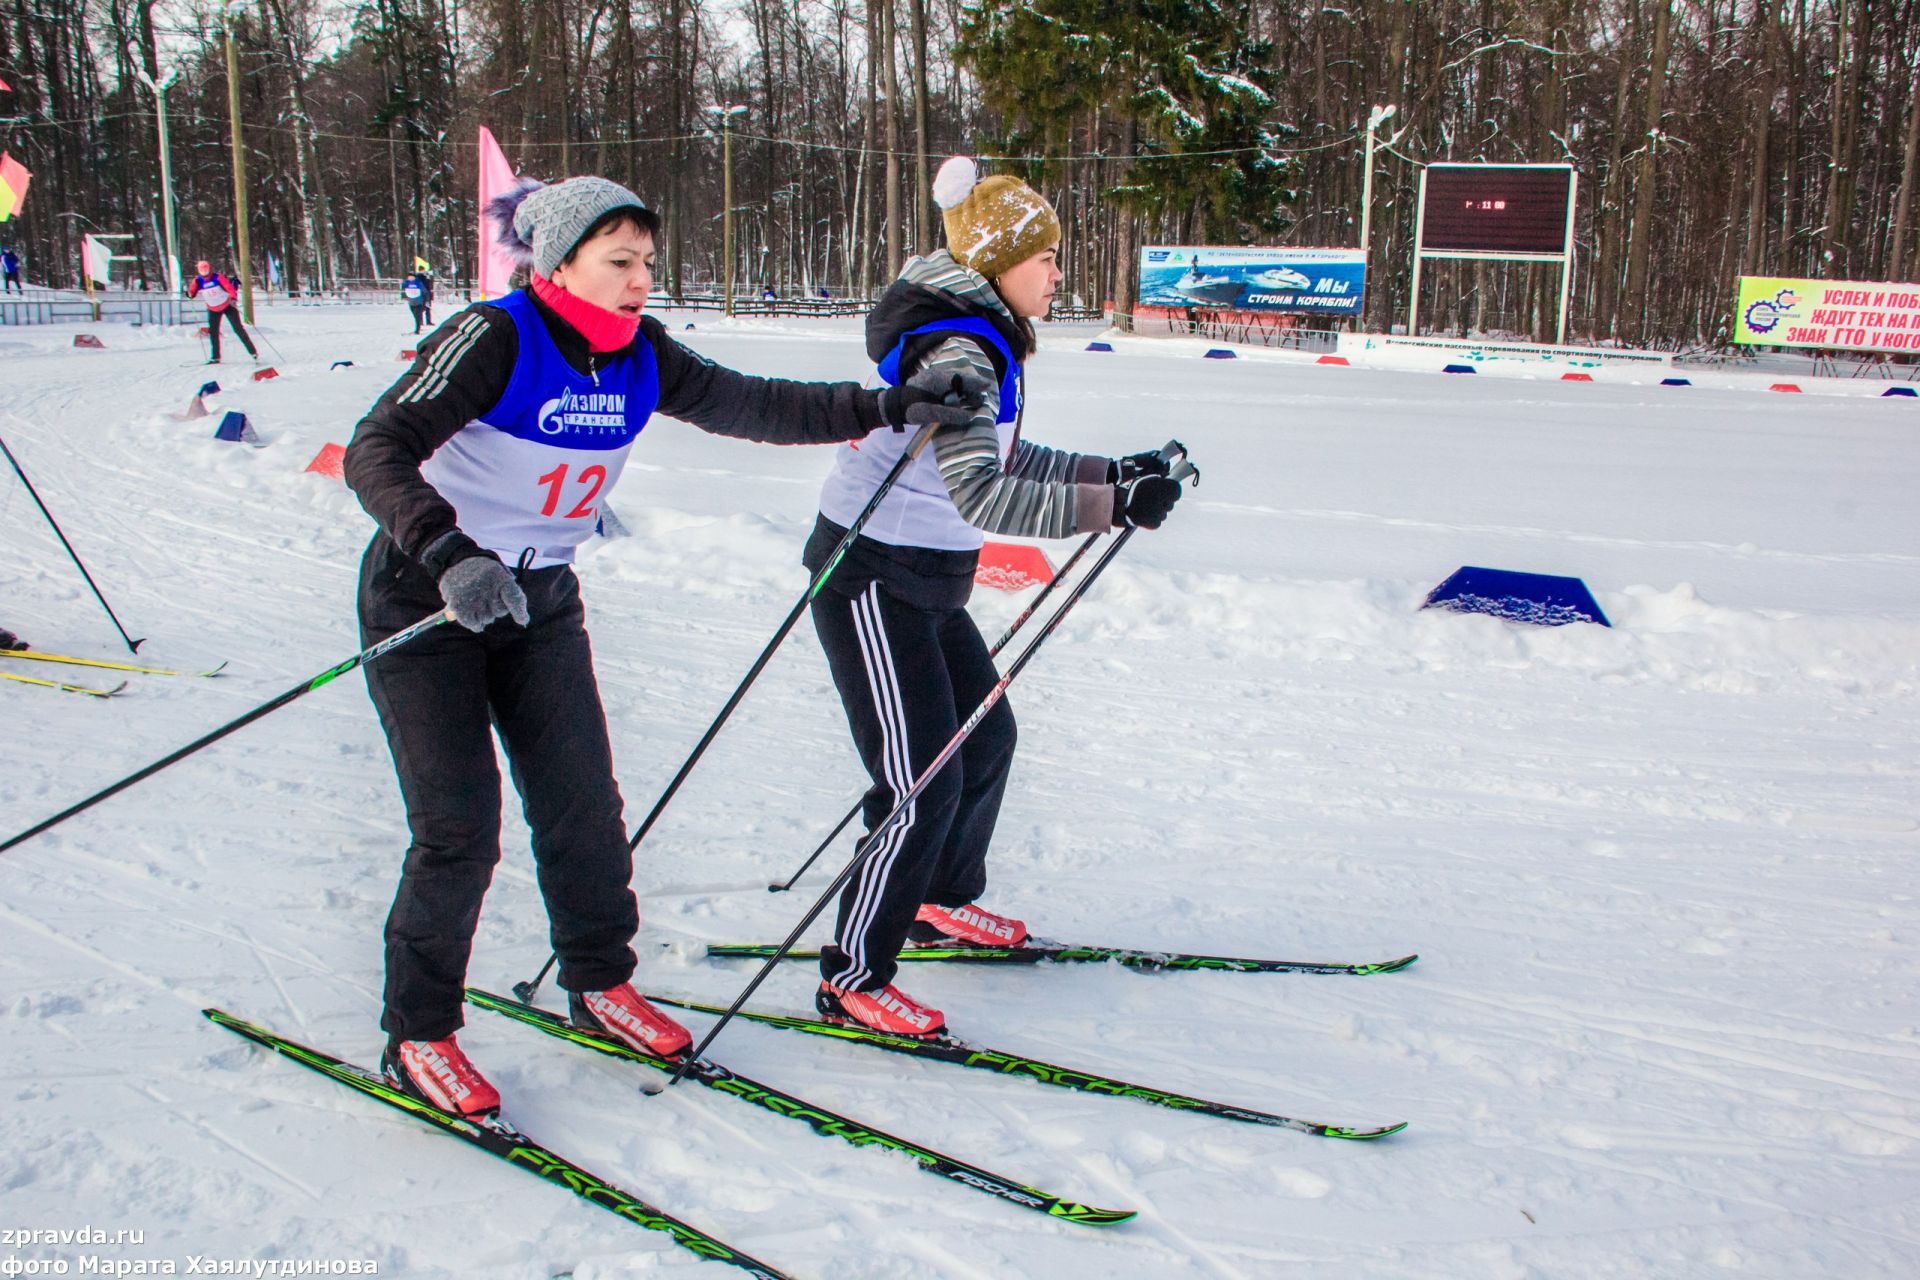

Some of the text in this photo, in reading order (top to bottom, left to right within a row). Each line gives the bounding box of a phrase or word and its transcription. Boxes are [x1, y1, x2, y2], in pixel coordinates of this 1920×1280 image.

[1314, 278, 1349, 294] Мы
[1248, 293, 1358, 308] СТРОИМ КОРАБЛИ!
[1823, 289, 1920, 309] УСПЕХ И ПОБ
[1811, 309, 1857, 326] ЖДУТ
[1859, 311, 1885, 328] ТЕХ
[1886, 313, 1908, 329] НА
[1786, 327, 1920, 348] ЗНАК ГТО У КОГО
[1552, 350, 1602, 360] спортивному
[562, 393, 626, 413] ГАЗПРОМ
[564, 426, 627, 435] КАЗАНЬ
[537, 463, 607, 519] 12
[582, 991, 659, 1043] pina
[949, 1171, 1045, 1209] FISCHER
